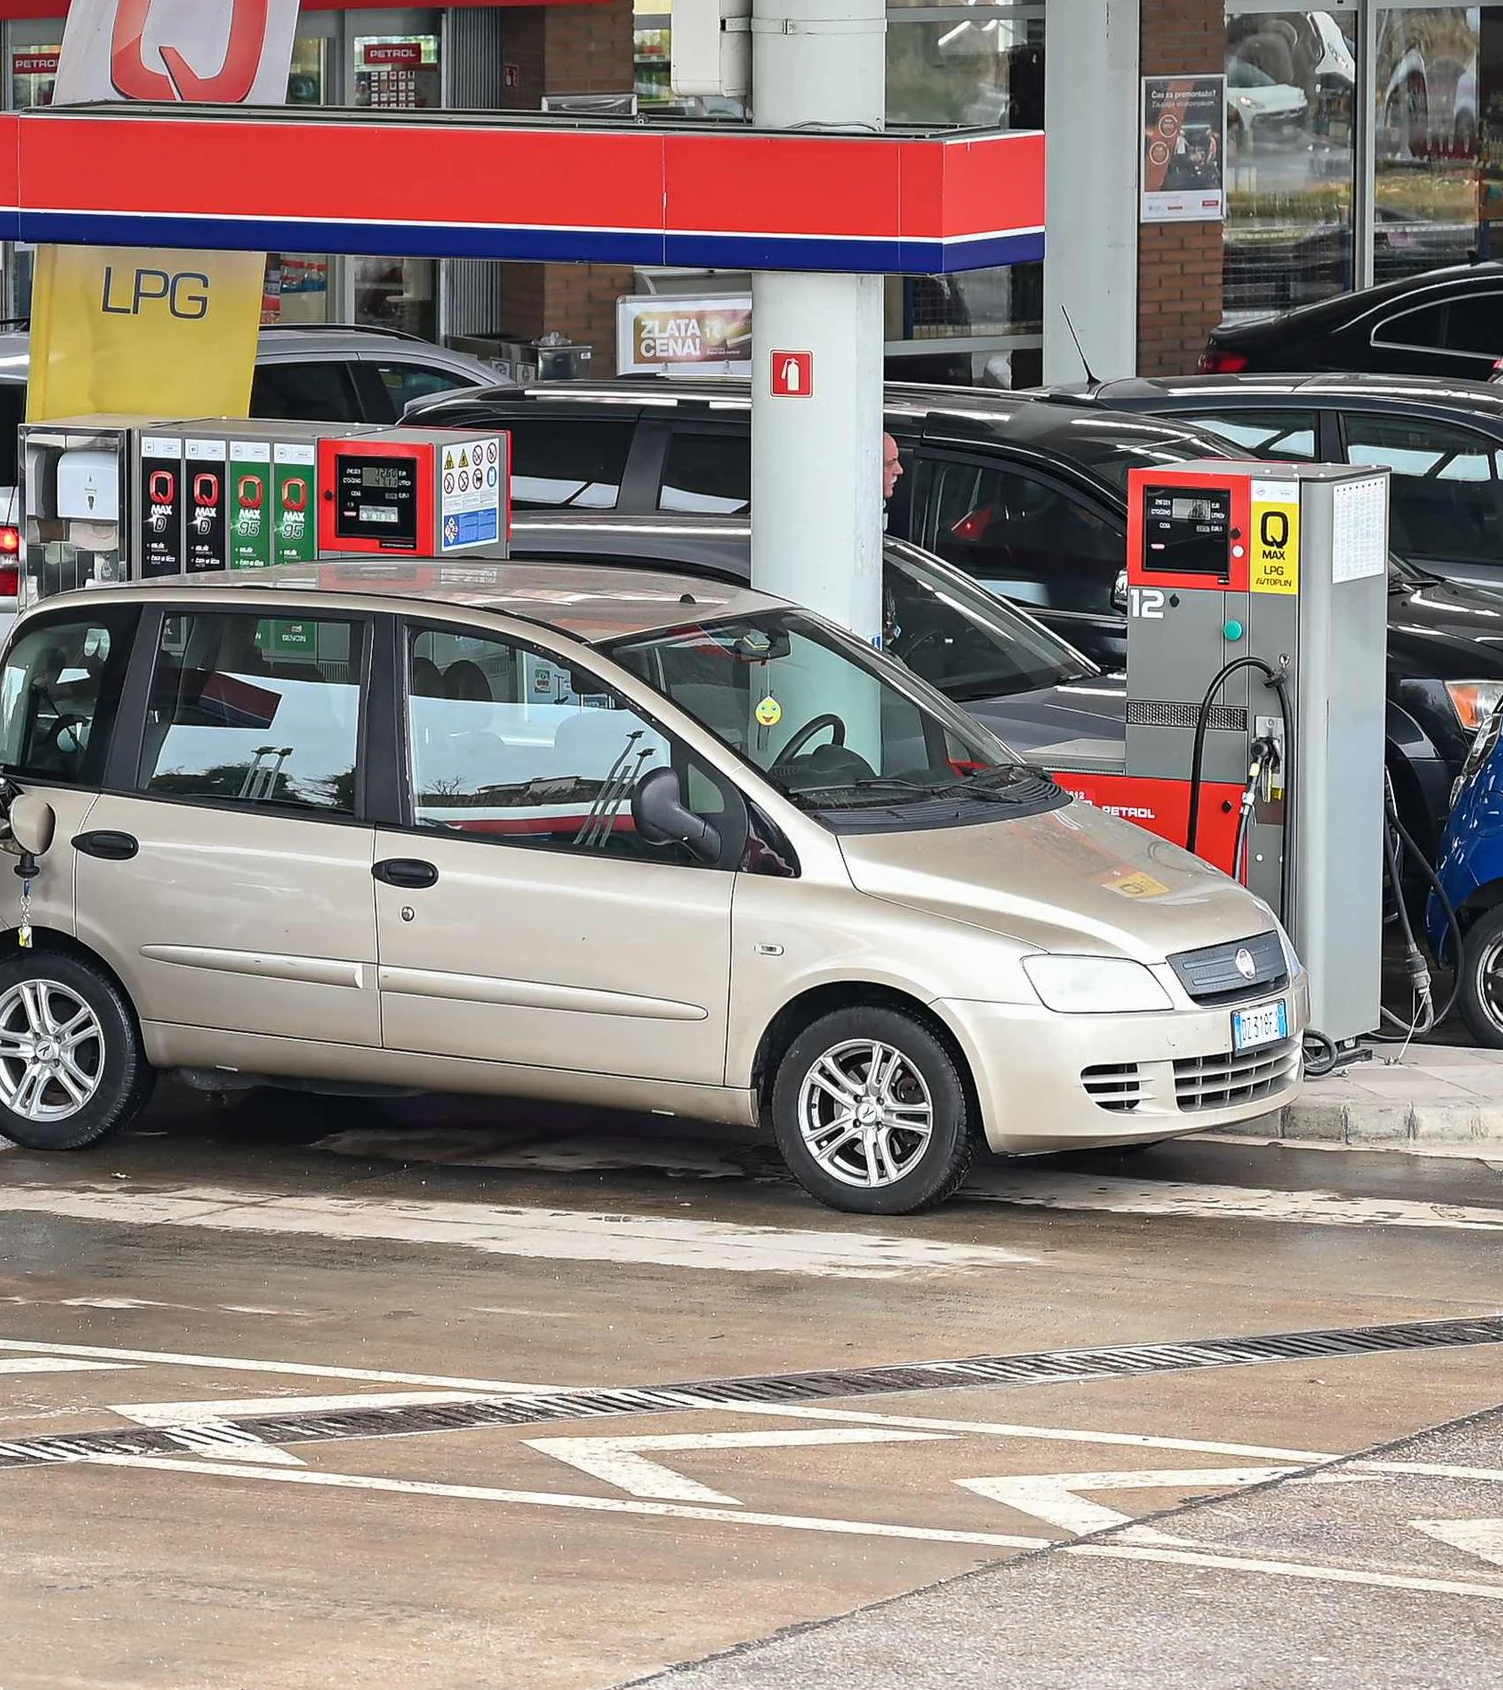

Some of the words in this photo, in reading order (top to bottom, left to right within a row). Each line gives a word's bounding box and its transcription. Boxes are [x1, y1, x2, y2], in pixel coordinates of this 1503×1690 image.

[369, 49, 416, 59] PETROL
[15, 59, 58, 69] PETRO
[101, 265, 210, 320] LPG
[640, 318, 701, 338] ZLATA
[640, 338, 700, 358] CENA!
[149, 470, 175, 504] Q
[193, 473, 219, 507] Q
[237, 475, 264, 509] Q
[281, 477, 308, 512] Q
[150, 504, 173, 516] MAX
[194, 507, 217, 518] MAX
[238, 509, 261, 520] MAX
[282, 511, 305, 522] MAX
[237, 520, 261, 537] 95
[282, 523, 304, 540] 95
[1260, 511, 1289, 549] Q
[1262, 550, 1286, 560] MAX
[1263, 565, 1285, 576] LPG
[1255, 577, 1292, 587] AVTOPLIN
[1130, 589, 1165, 619] 12
[1101, 805, 1156, 819] PETROL
